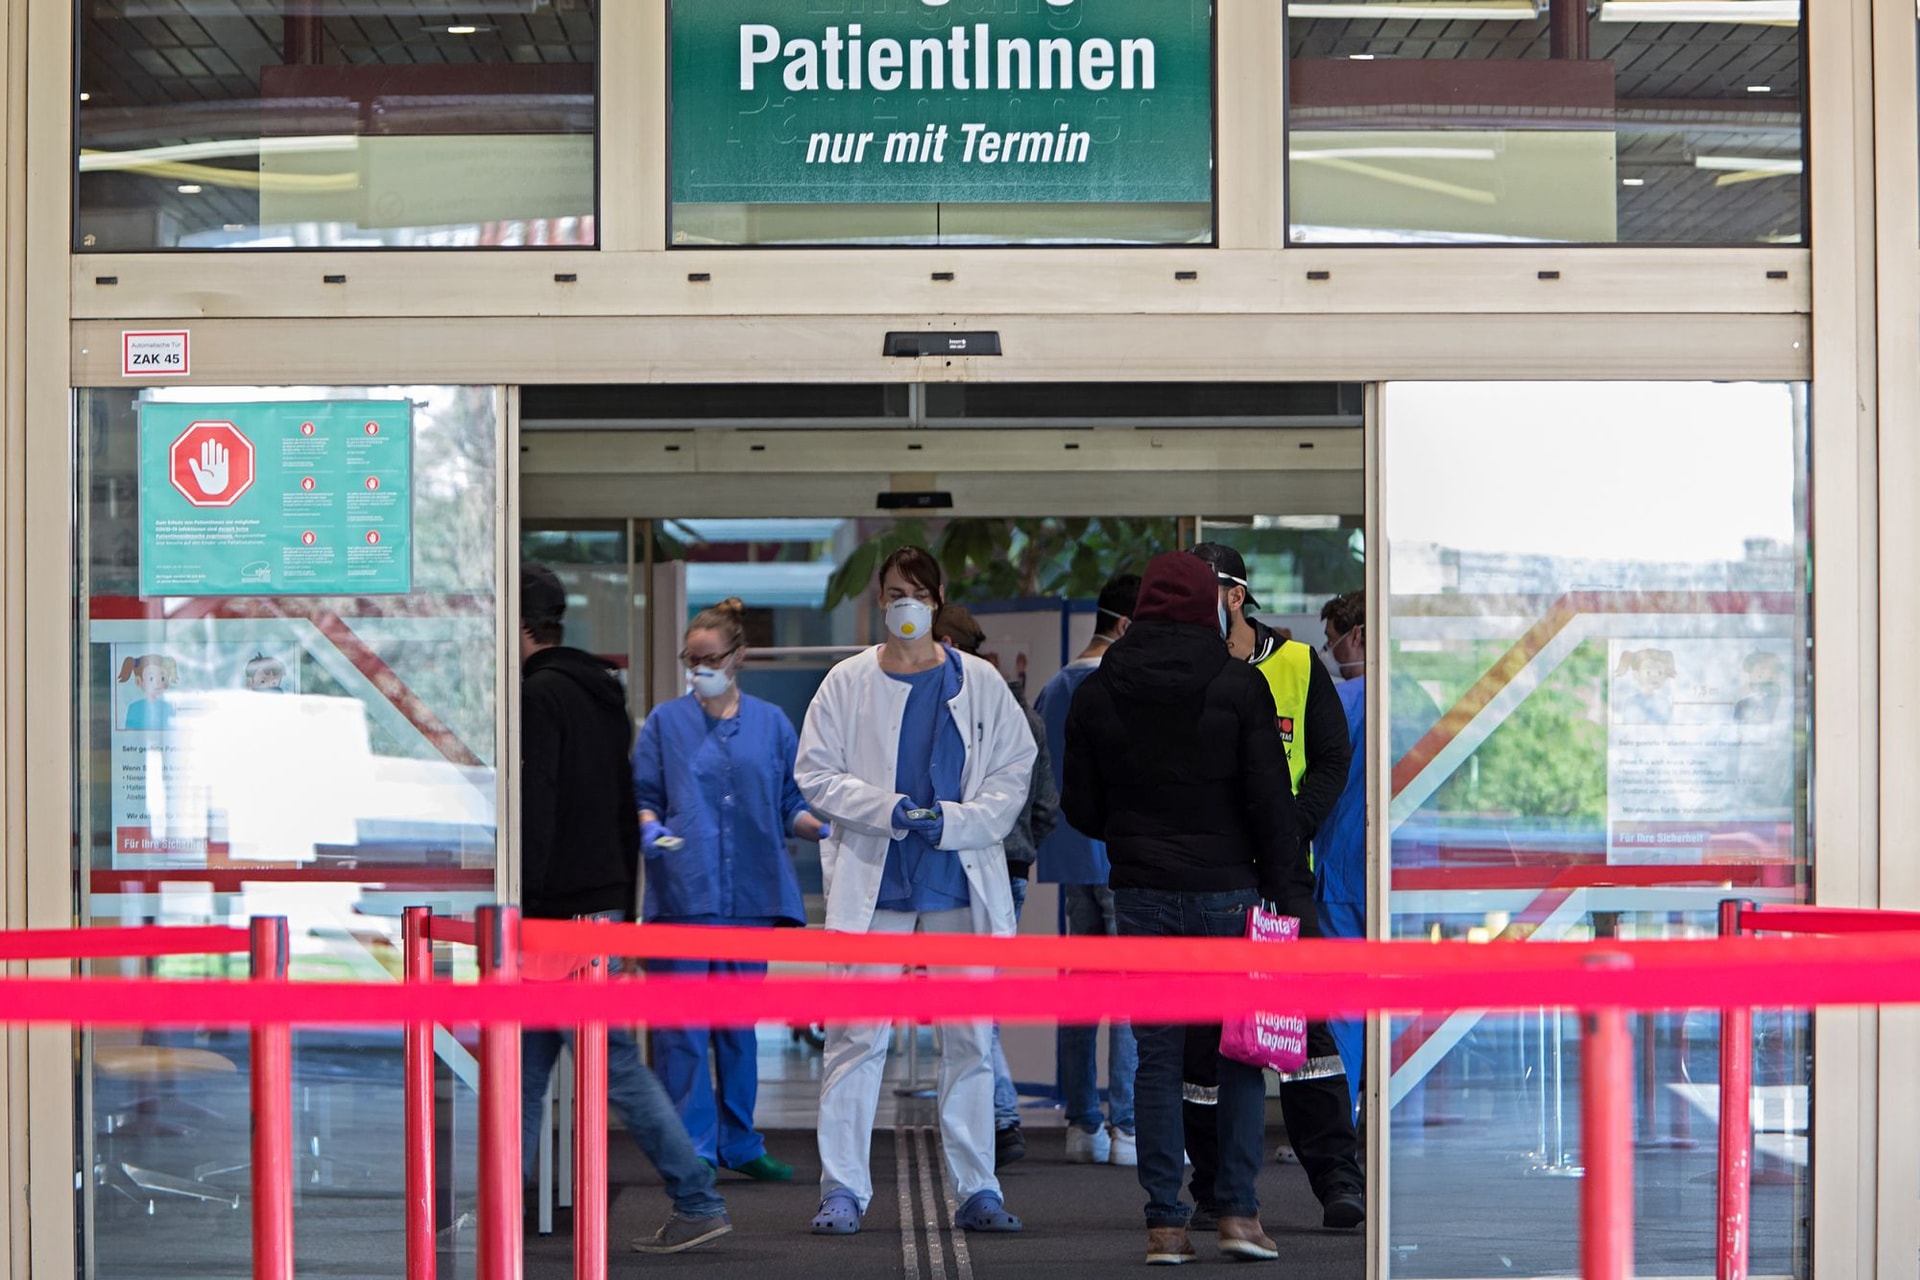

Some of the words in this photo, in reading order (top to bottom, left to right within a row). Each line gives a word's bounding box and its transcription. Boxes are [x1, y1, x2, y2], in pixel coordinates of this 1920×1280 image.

[738, 23, 1156, 92] PatientInnen
[805, 129, 873, 164] nur
[883, 123, 948, 164] mit
[959, 123, 1091, 164] Termin
[133, 353, 160, 365] ZAK
[164, 353, 180, 365] 45
[1620, 831, 1634, 843] Für
[1636, 831, 1655, 843] Ihre
[124, 838, 139, 849] Für
[141, 838, 159, 849] Ihre
